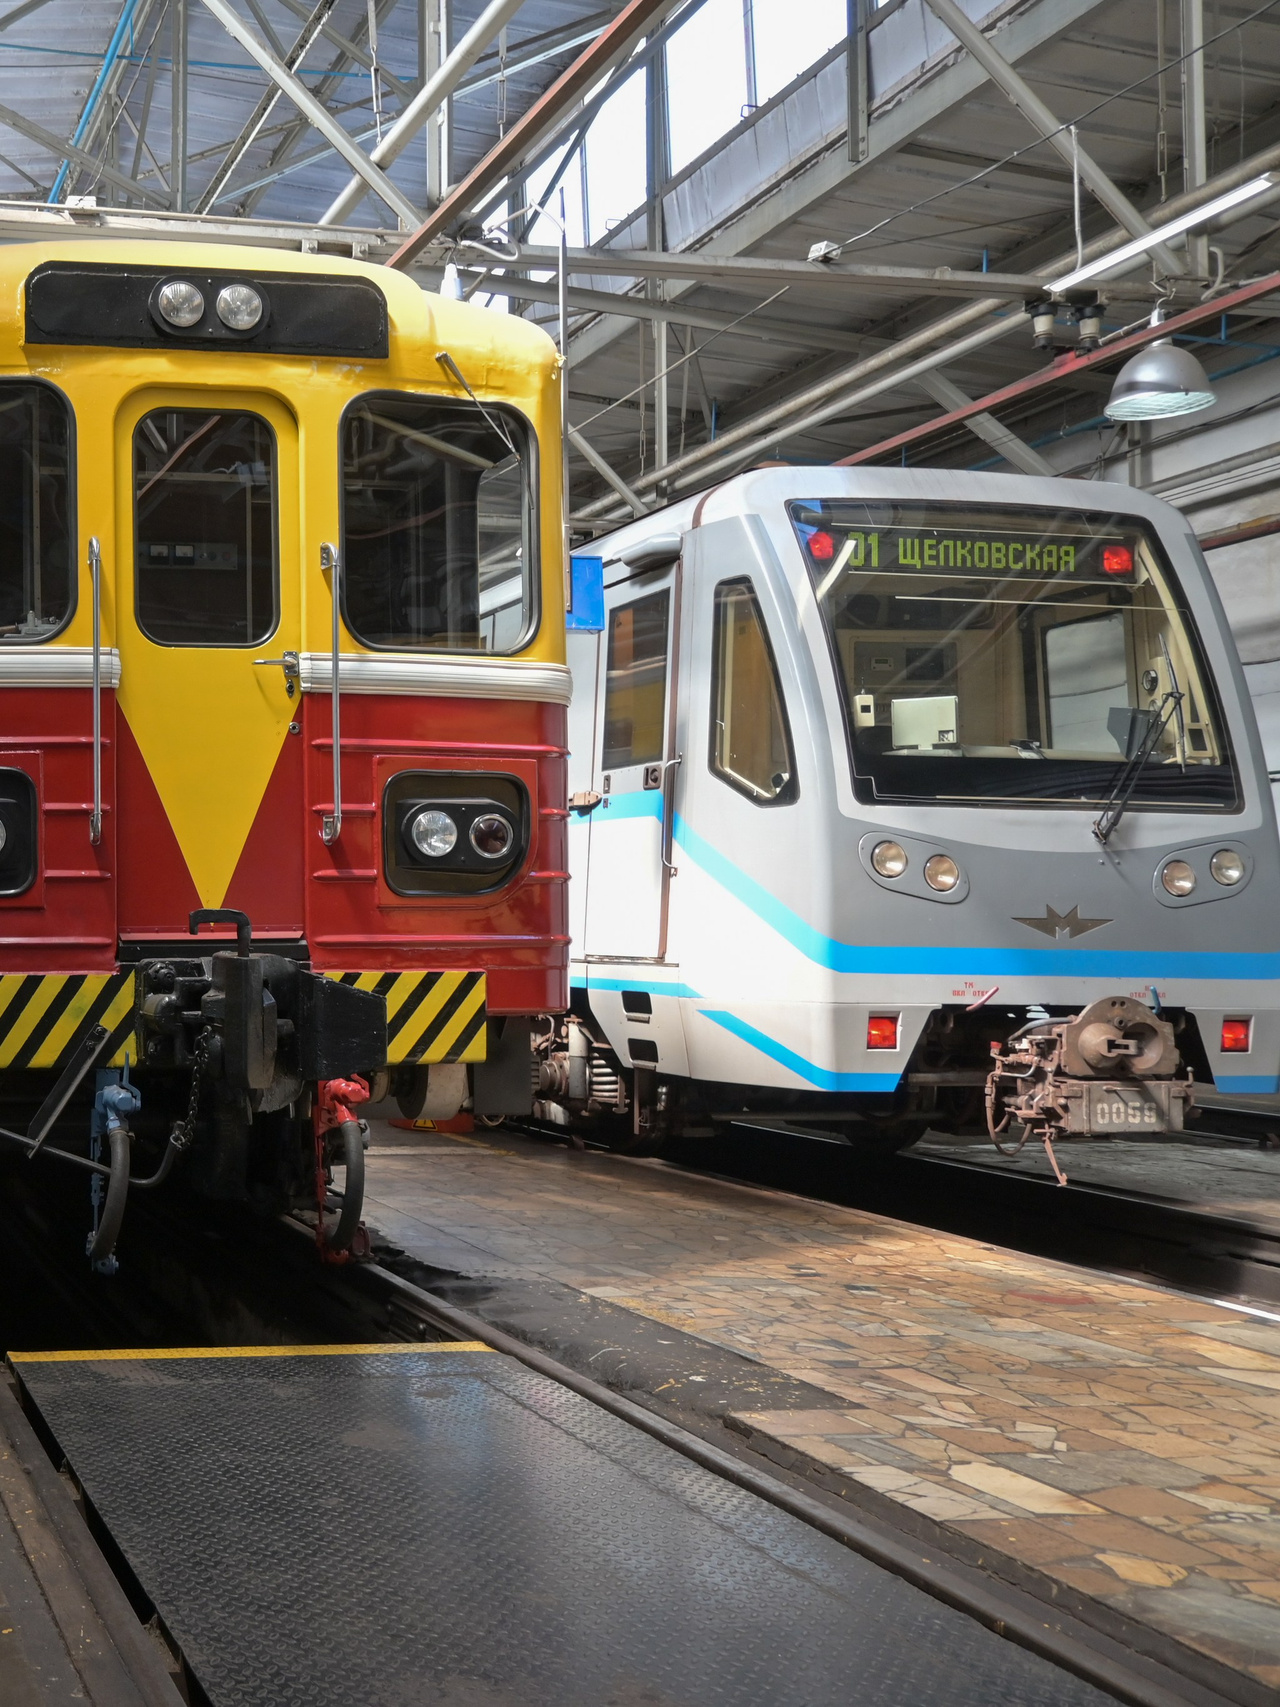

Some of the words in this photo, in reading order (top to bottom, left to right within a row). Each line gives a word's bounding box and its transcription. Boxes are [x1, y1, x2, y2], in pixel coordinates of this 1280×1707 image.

[847, 532, 879, 567] 01
[898, 537, 1076, 572] ЩЕЛКОВСКАЯ
[1096, 1101, 1157, 1125] 0059
